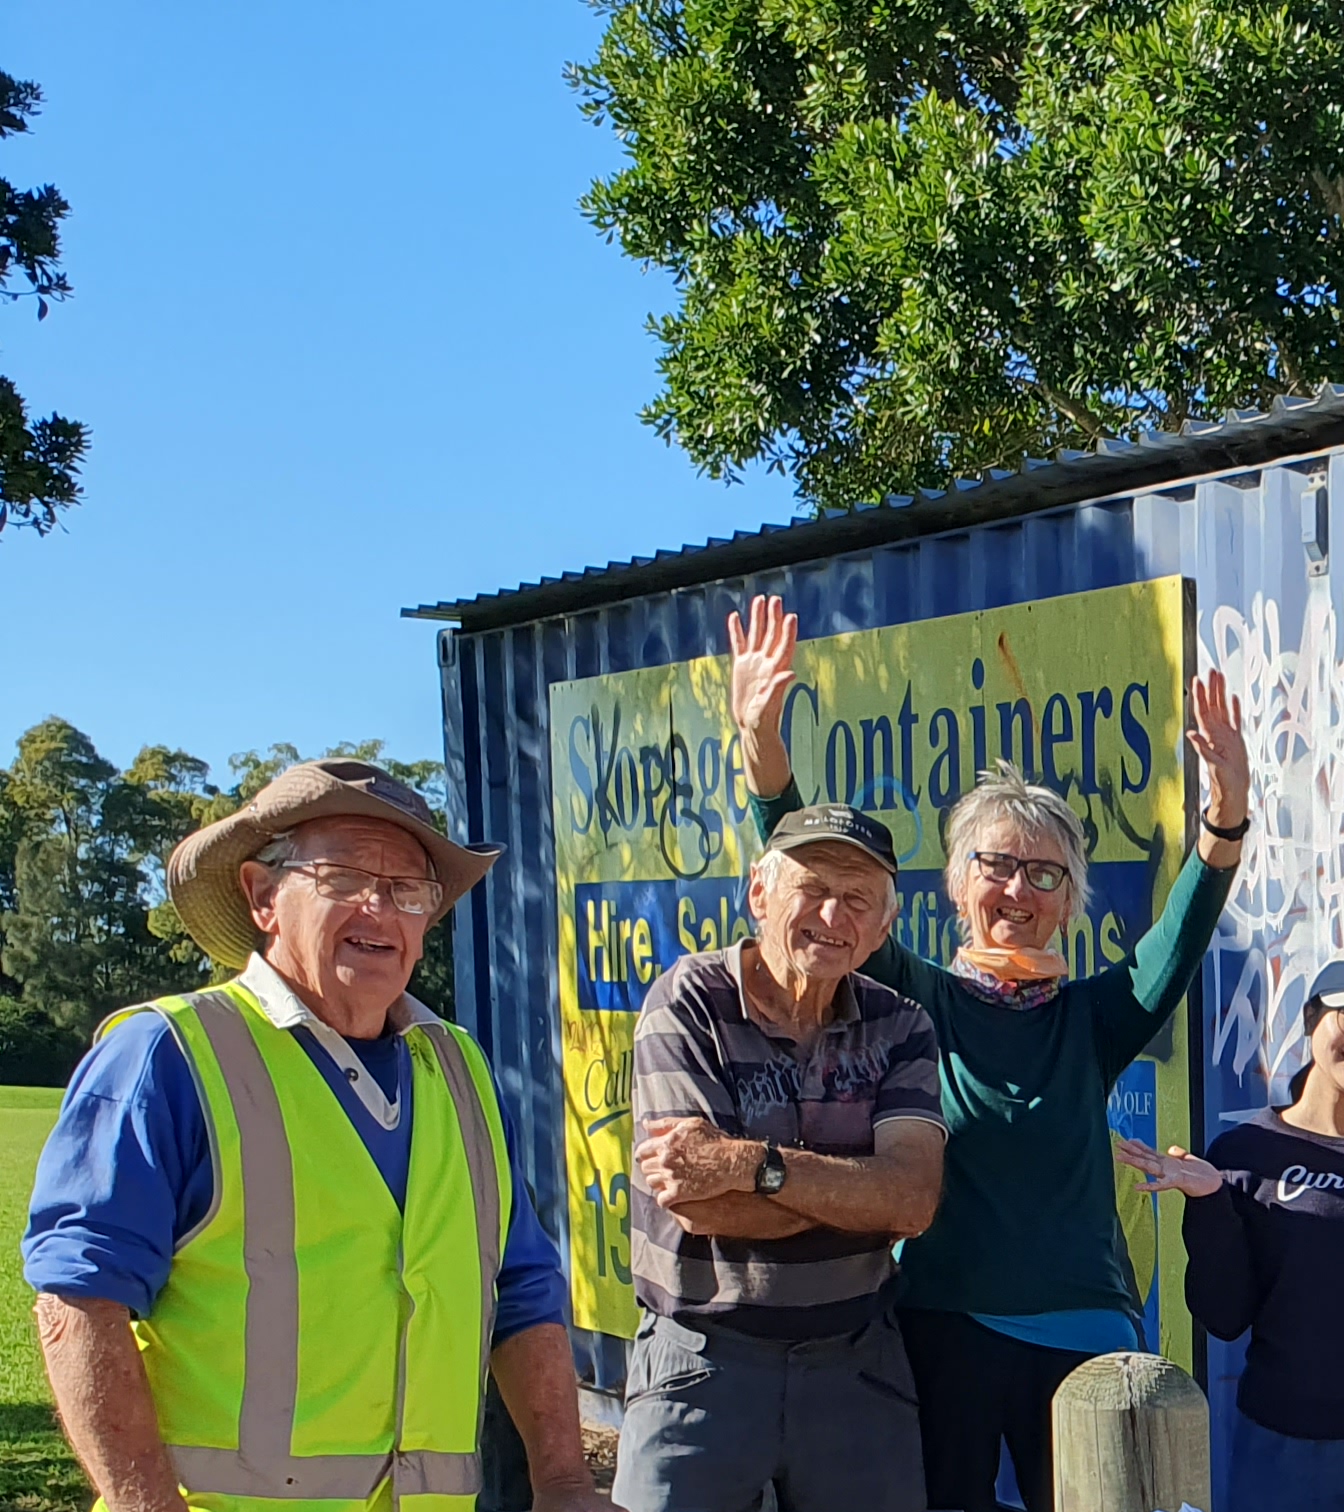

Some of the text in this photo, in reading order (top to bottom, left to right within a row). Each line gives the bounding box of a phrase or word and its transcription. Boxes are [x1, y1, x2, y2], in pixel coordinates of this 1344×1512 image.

[780, 657, 1153, 812] Containers
[584, 1051, 632, 1112] Call
[1106, 1081, 1152, 1116] WOLF
[585, 1168, 633, 1285] 13
